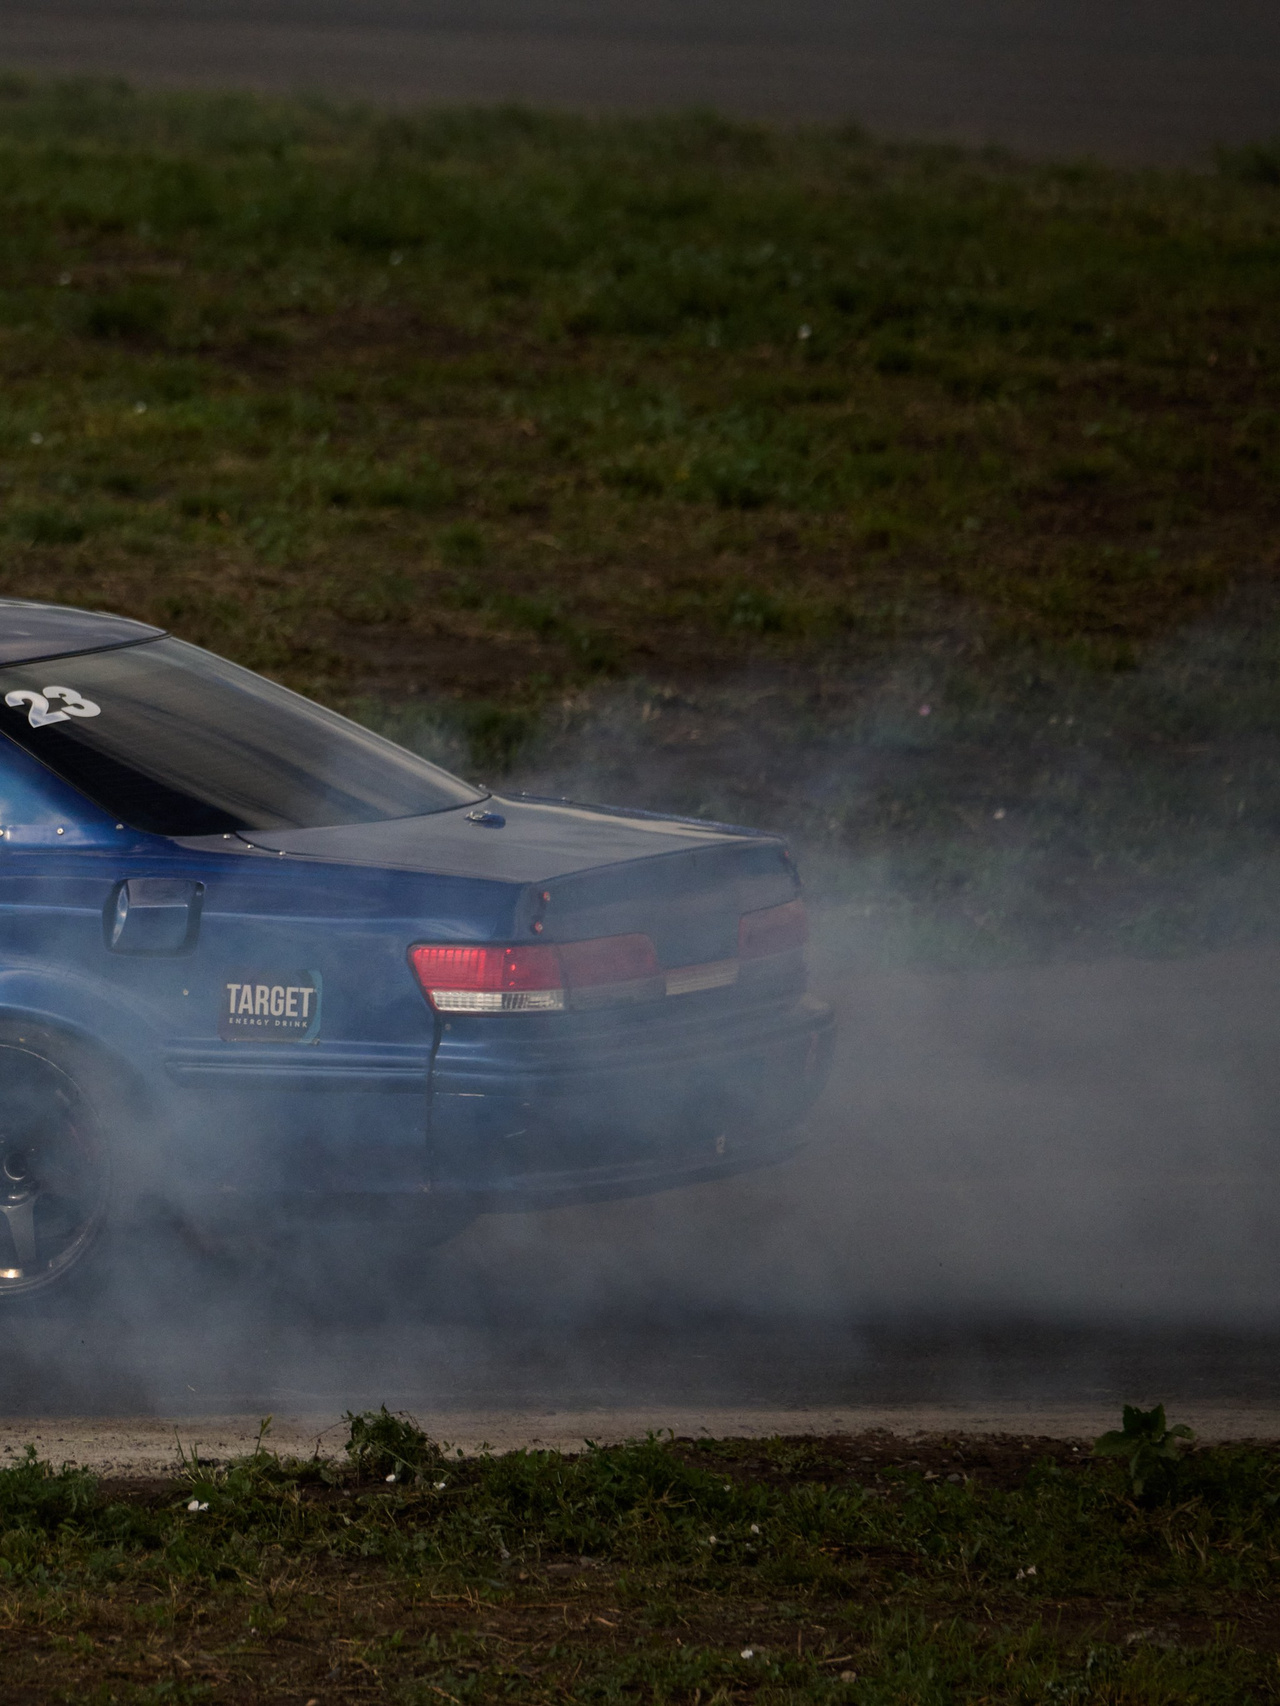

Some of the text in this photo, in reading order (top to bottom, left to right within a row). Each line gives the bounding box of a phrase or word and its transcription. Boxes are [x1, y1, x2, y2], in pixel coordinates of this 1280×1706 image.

[5, 686, 101, 729] 23
[227, 983, 314, 1018] TARGET
[229, 1018, 308, 1028] ENERGY DRINK
